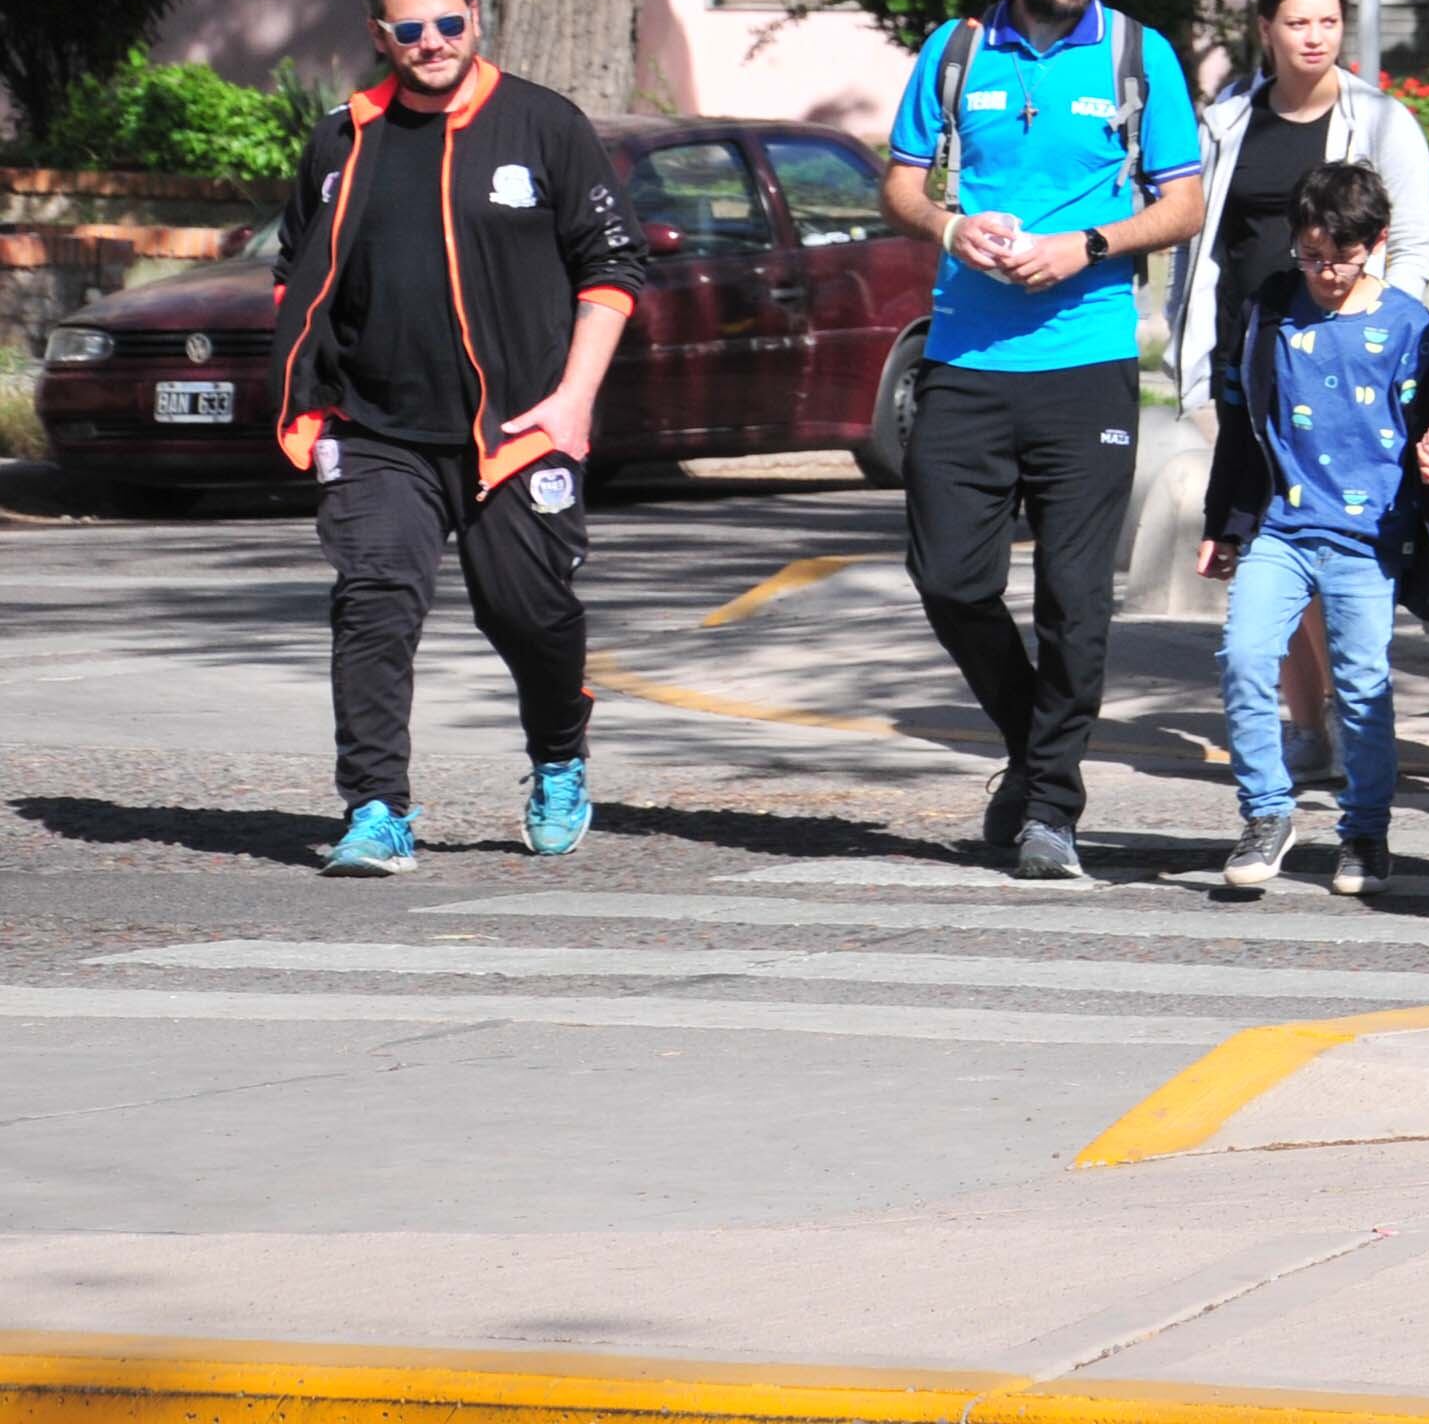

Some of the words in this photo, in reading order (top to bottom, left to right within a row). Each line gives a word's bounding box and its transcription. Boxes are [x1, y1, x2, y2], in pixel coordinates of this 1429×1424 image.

[966, 90, 1007, 112] TEAM
[158, 392, 189, 414] BAN
[198, 392, 229, 414] 633
